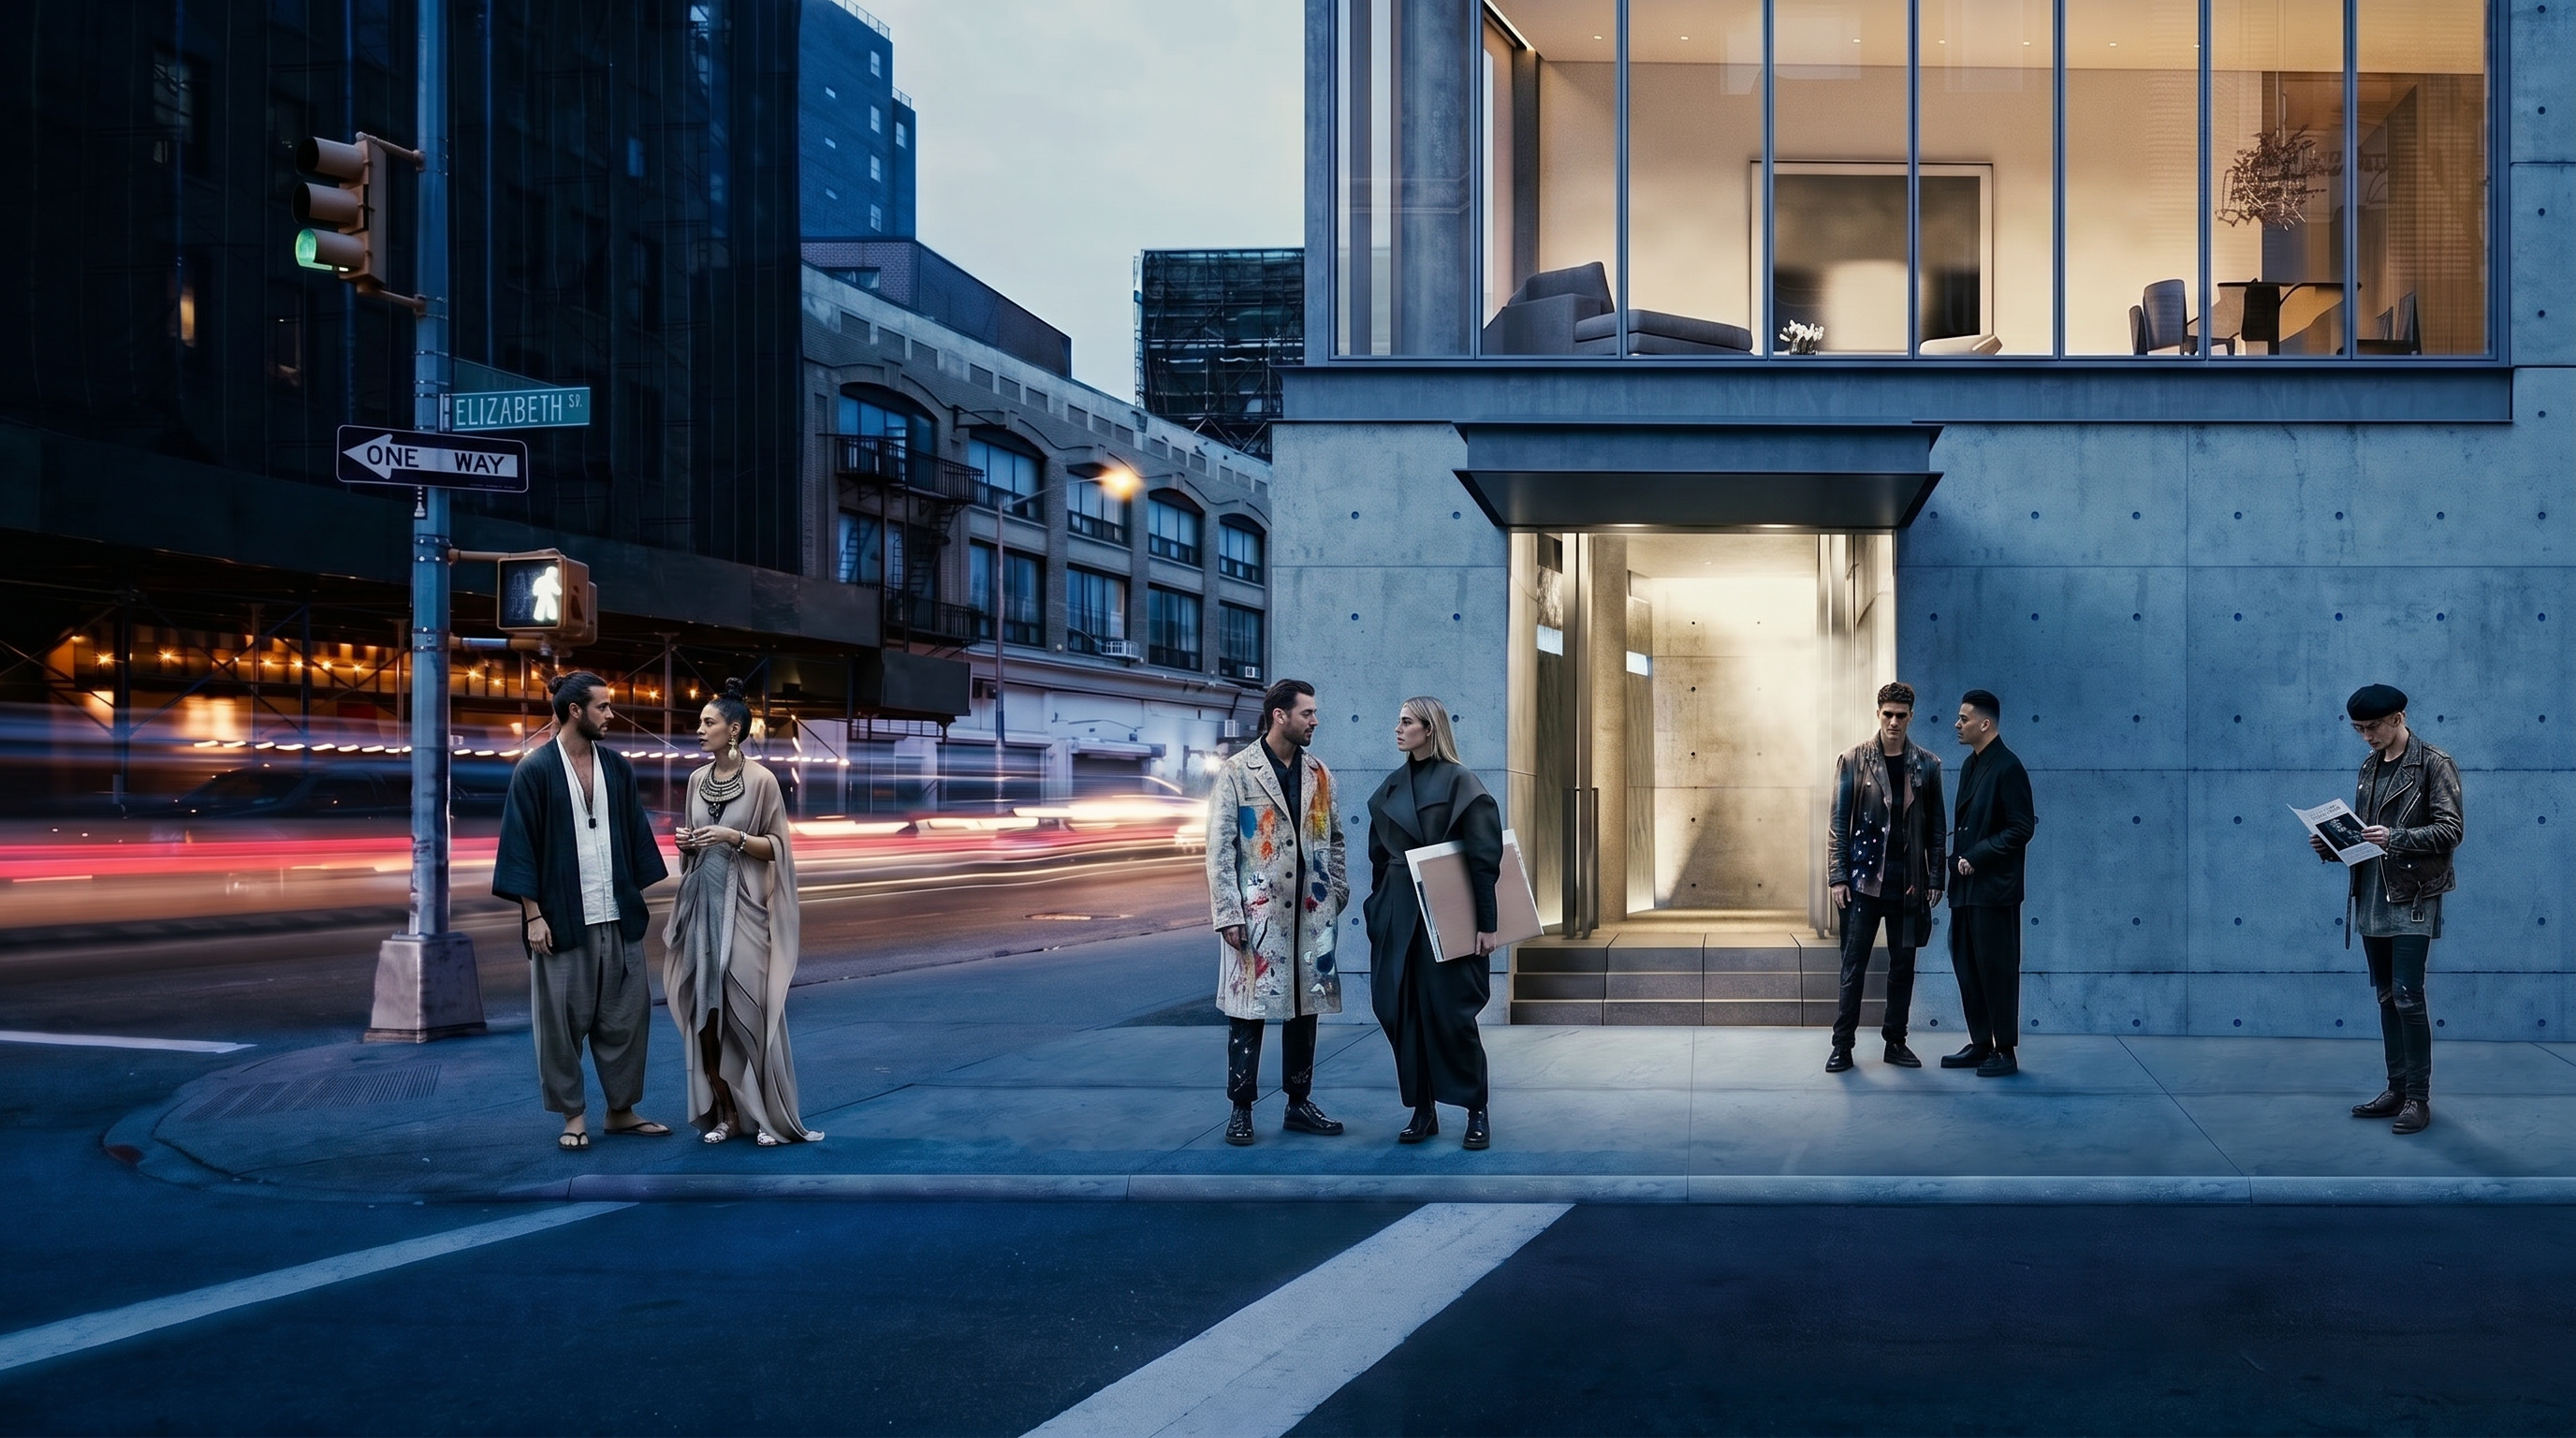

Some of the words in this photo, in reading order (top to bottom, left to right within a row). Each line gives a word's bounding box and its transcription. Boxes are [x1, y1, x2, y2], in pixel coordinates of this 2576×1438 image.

[456, 394, 563, 426] ELIZABETH
[367, 445, 419, 468] ONE
[454, 452, 505, 475] WAY
